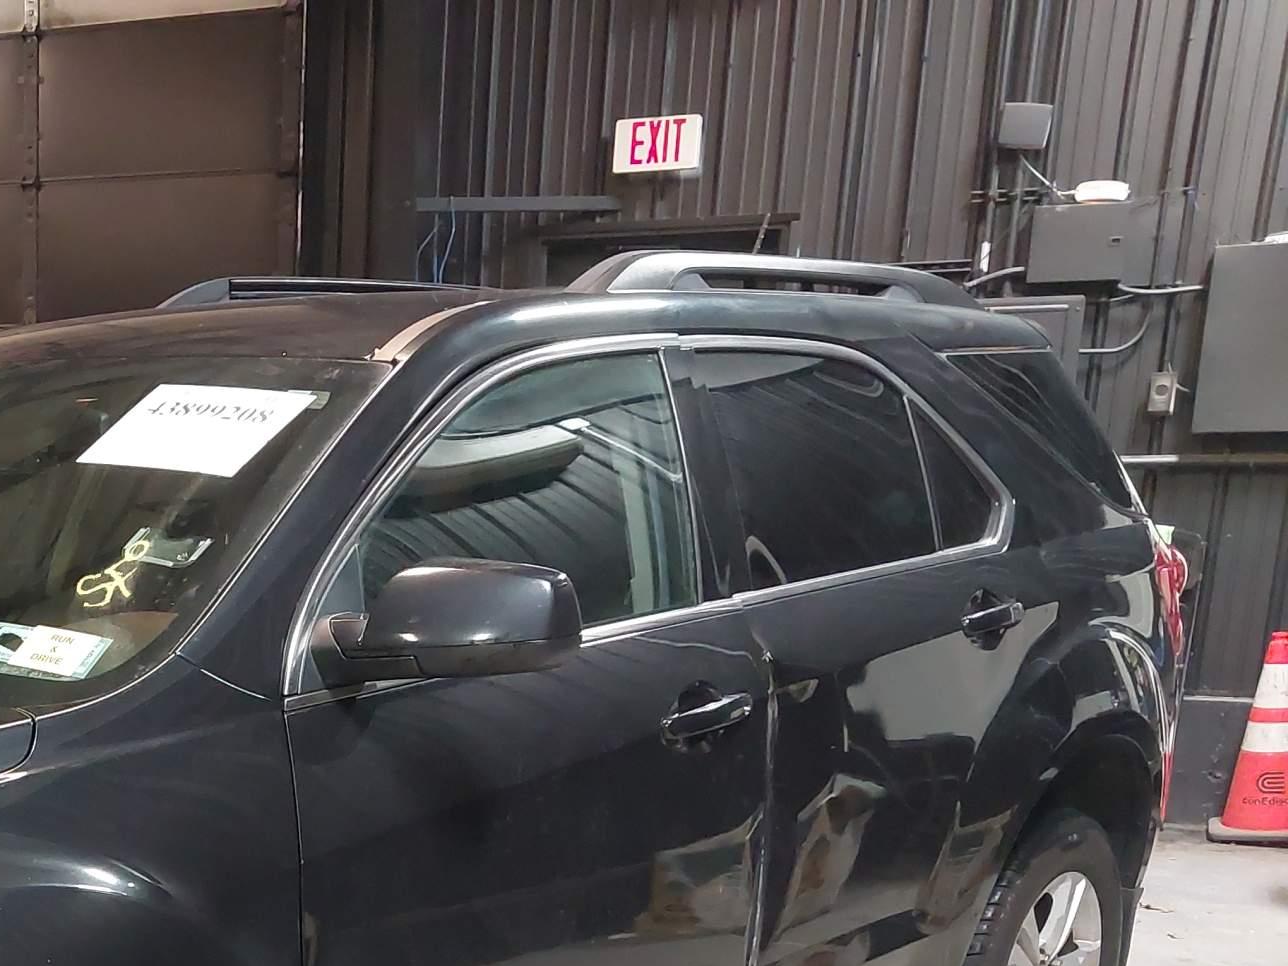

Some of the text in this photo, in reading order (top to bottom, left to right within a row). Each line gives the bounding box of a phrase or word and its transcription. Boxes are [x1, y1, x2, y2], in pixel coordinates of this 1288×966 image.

[630, 118, 687, 165] EXIT
[147, 401, 275, 423] 43899208
[50, 634, 75, 645] RUN
[30, 653, 63, 665] DRIVE
